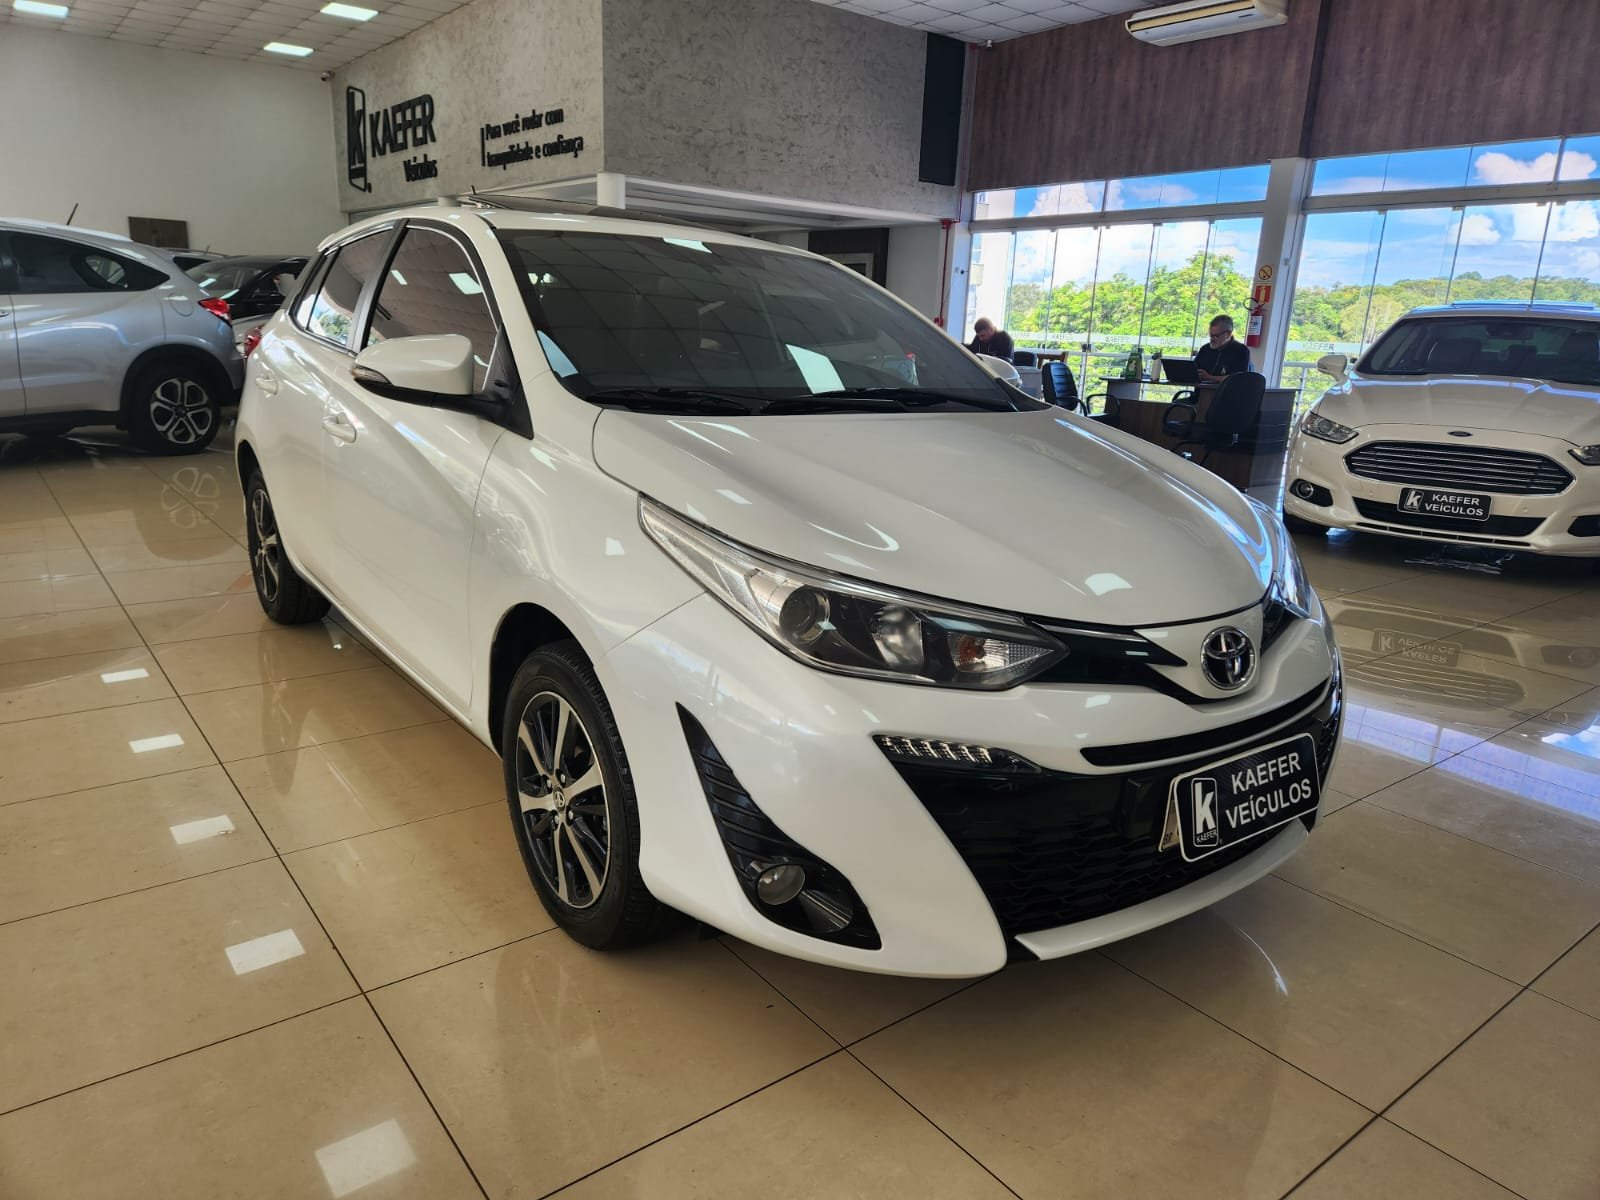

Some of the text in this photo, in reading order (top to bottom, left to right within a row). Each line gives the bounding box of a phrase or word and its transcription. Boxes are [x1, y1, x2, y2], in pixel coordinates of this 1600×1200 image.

[369, 94, 436, 158] KAEFER
[485, 123, 502, 141] Para
[502, 113, 521, 136] você
[545, 108, 564, 126] com
[535, 144, 541, 159] e
[543, 134, 584, 158] confiança
[403, 153, 438, 182] Veículos
[1425, 503, 1484, 516] VEÍCULOS
[1432, 493, 1480, 506] KAEFER
[1231, 752, 1301, 795] KAEFER
[1225, 778, 1312, 829] VEÍCULOS
[1196, 829, 1217, 844] KAEFER
